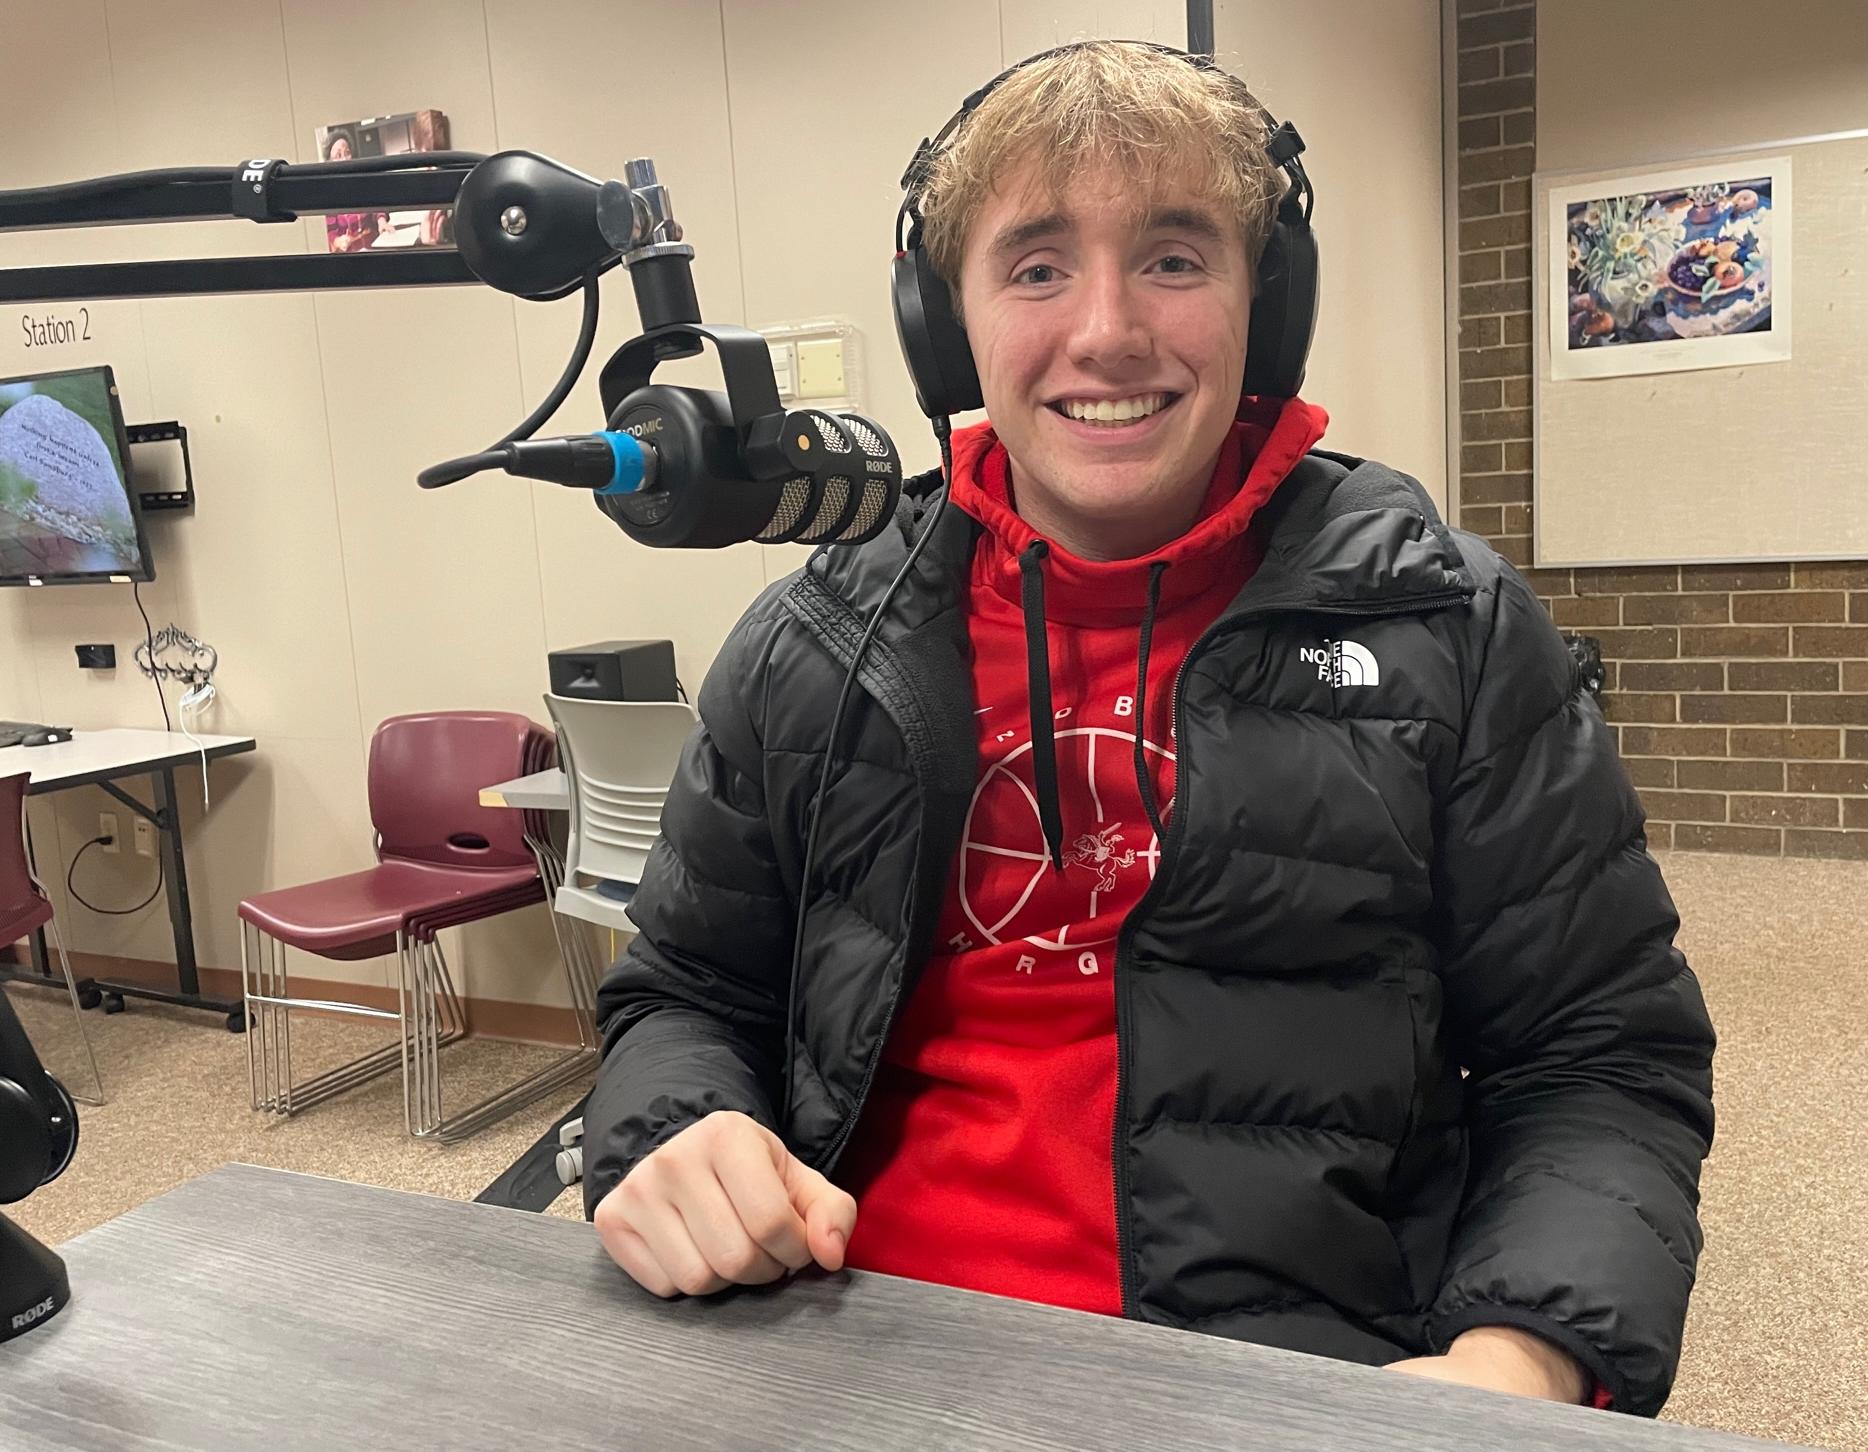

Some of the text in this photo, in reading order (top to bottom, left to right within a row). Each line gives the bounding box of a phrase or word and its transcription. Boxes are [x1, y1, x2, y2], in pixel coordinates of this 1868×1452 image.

[22, 307, 91, 347] Station 2
[615, 417, 663, 437] ODMIC
